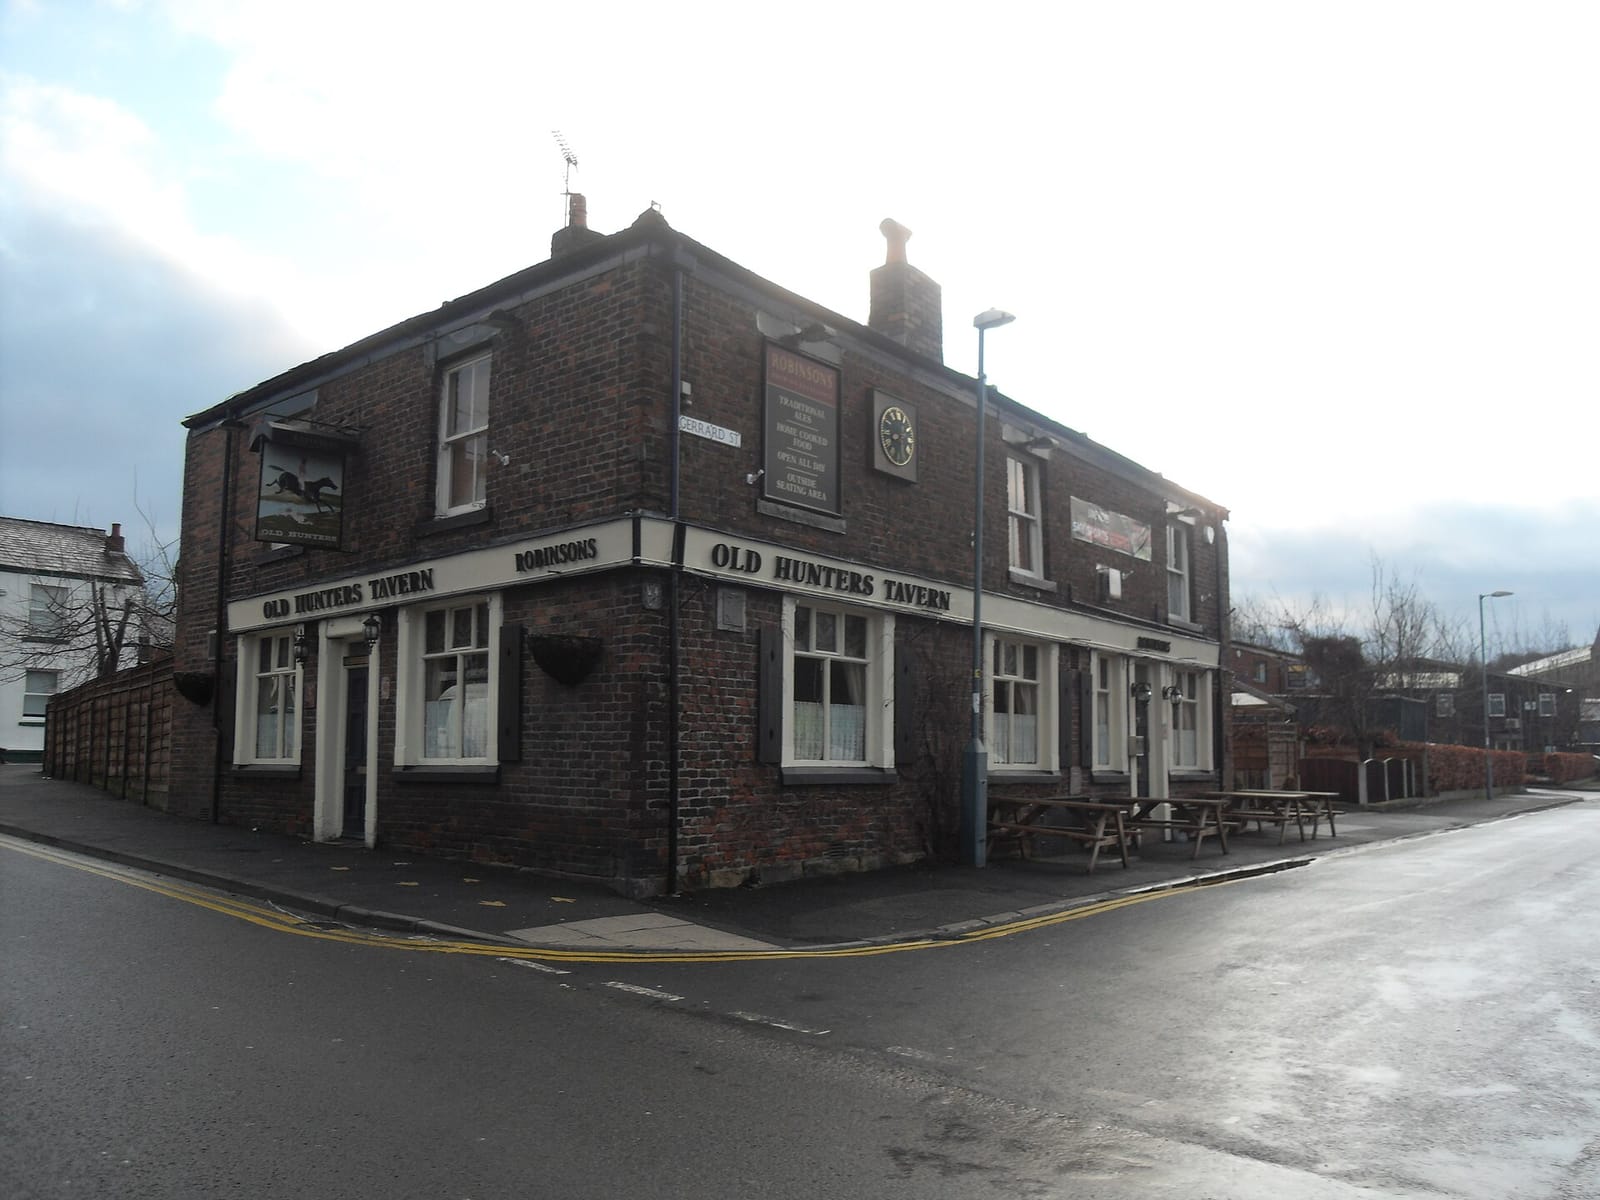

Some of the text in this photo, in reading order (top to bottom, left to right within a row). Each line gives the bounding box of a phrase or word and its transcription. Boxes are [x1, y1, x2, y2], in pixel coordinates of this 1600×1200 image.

[778, 395, 825, 418] TRADITIONAL
[680, 416, 740, 444] GERRARD ST
[776, 422, 828, 446] HOME COOKED
[793, 437, 812, 450] FOOD
[777, 451, 797, 464] OPEN
[799, 457, 812, 468] ALL
[776, 480, 826, 501] SEATING AREA
[786, 473, 816, 488] OUTSIDE
[262, 528, 337, 541] OLD HUNTERS
[515, 538, 597, 572] ROBINSONS
[711, 543, 951, 610] OLD HUNTERS TAVERN
[263, 568, 434, 618] OLD HUNTERS TAVERN
